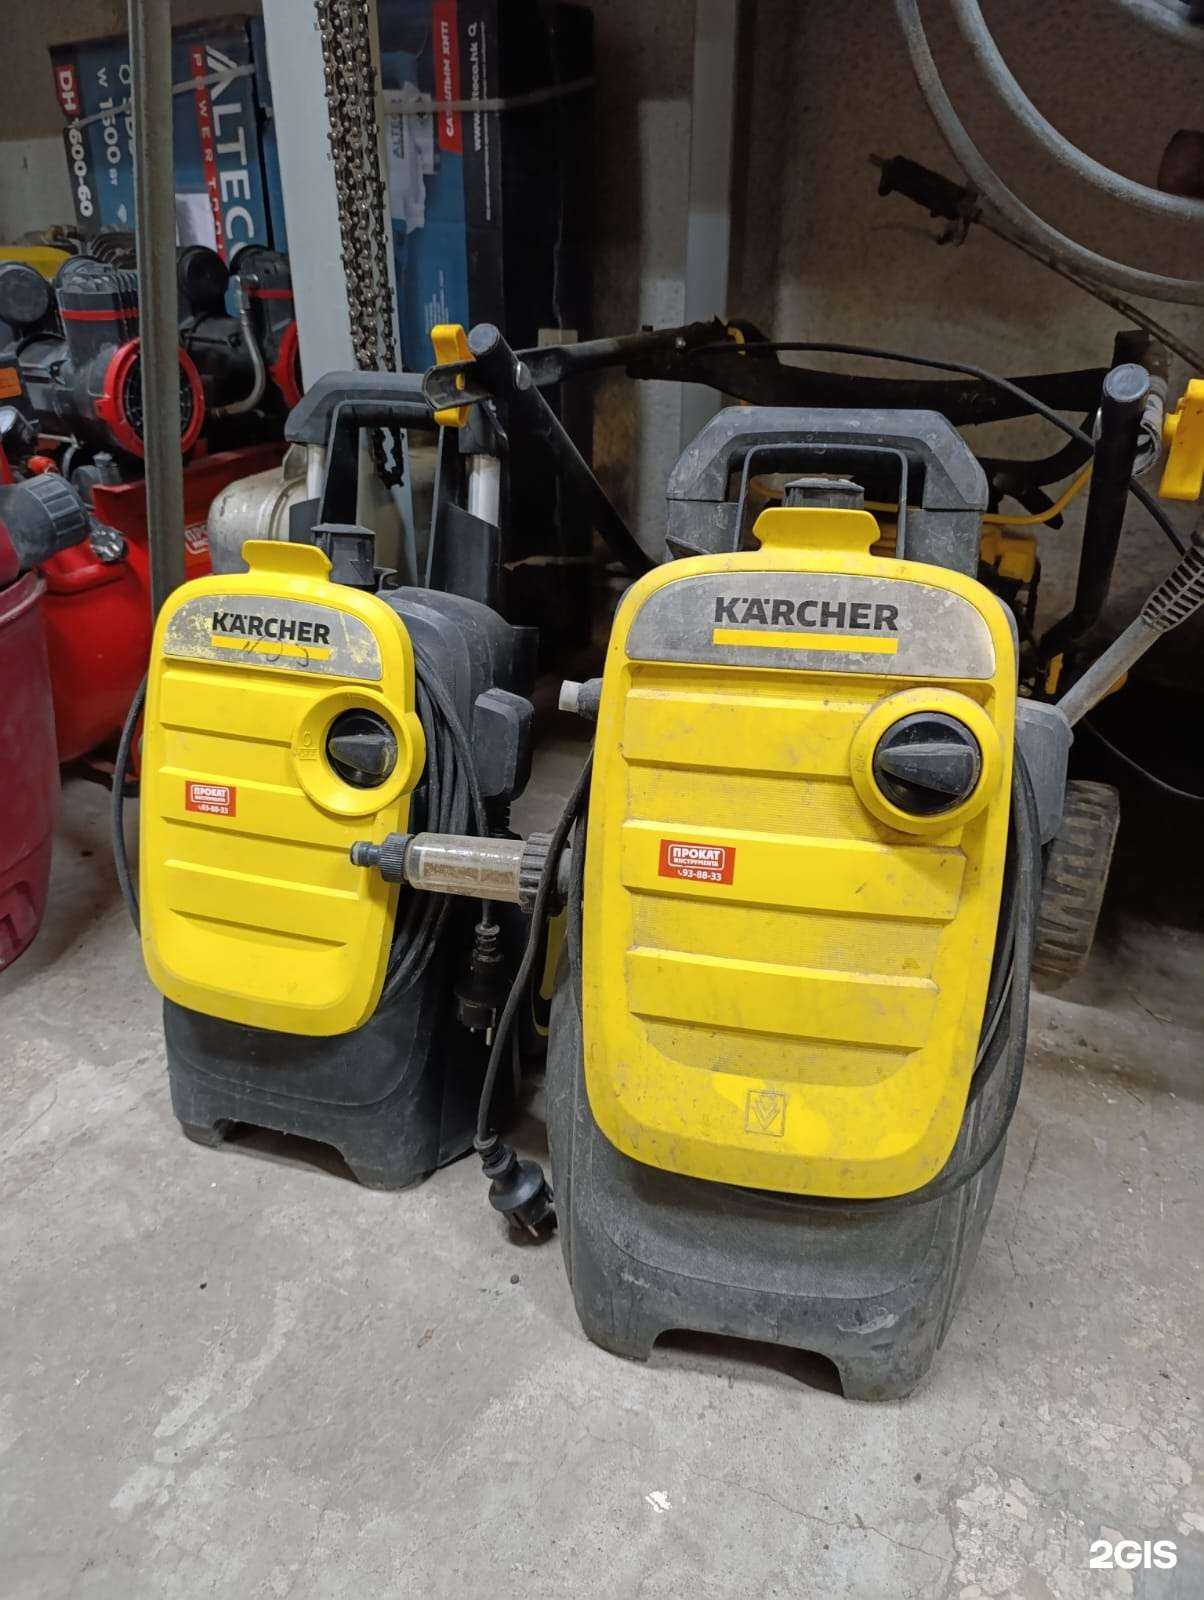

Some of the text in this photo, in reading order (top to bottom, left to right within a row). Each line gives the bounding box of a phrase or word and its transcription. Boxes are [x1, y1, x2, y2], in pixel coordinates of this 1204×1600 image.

[57, 70, 77, 112] DH
[212, 611, 331, 645] KÄRCHER
[713, 596, 899, 631] KÄRCHER
[672, 847, 721, 861] ПРОКАТ
[682, 868, 722, 882] 93-88-33
